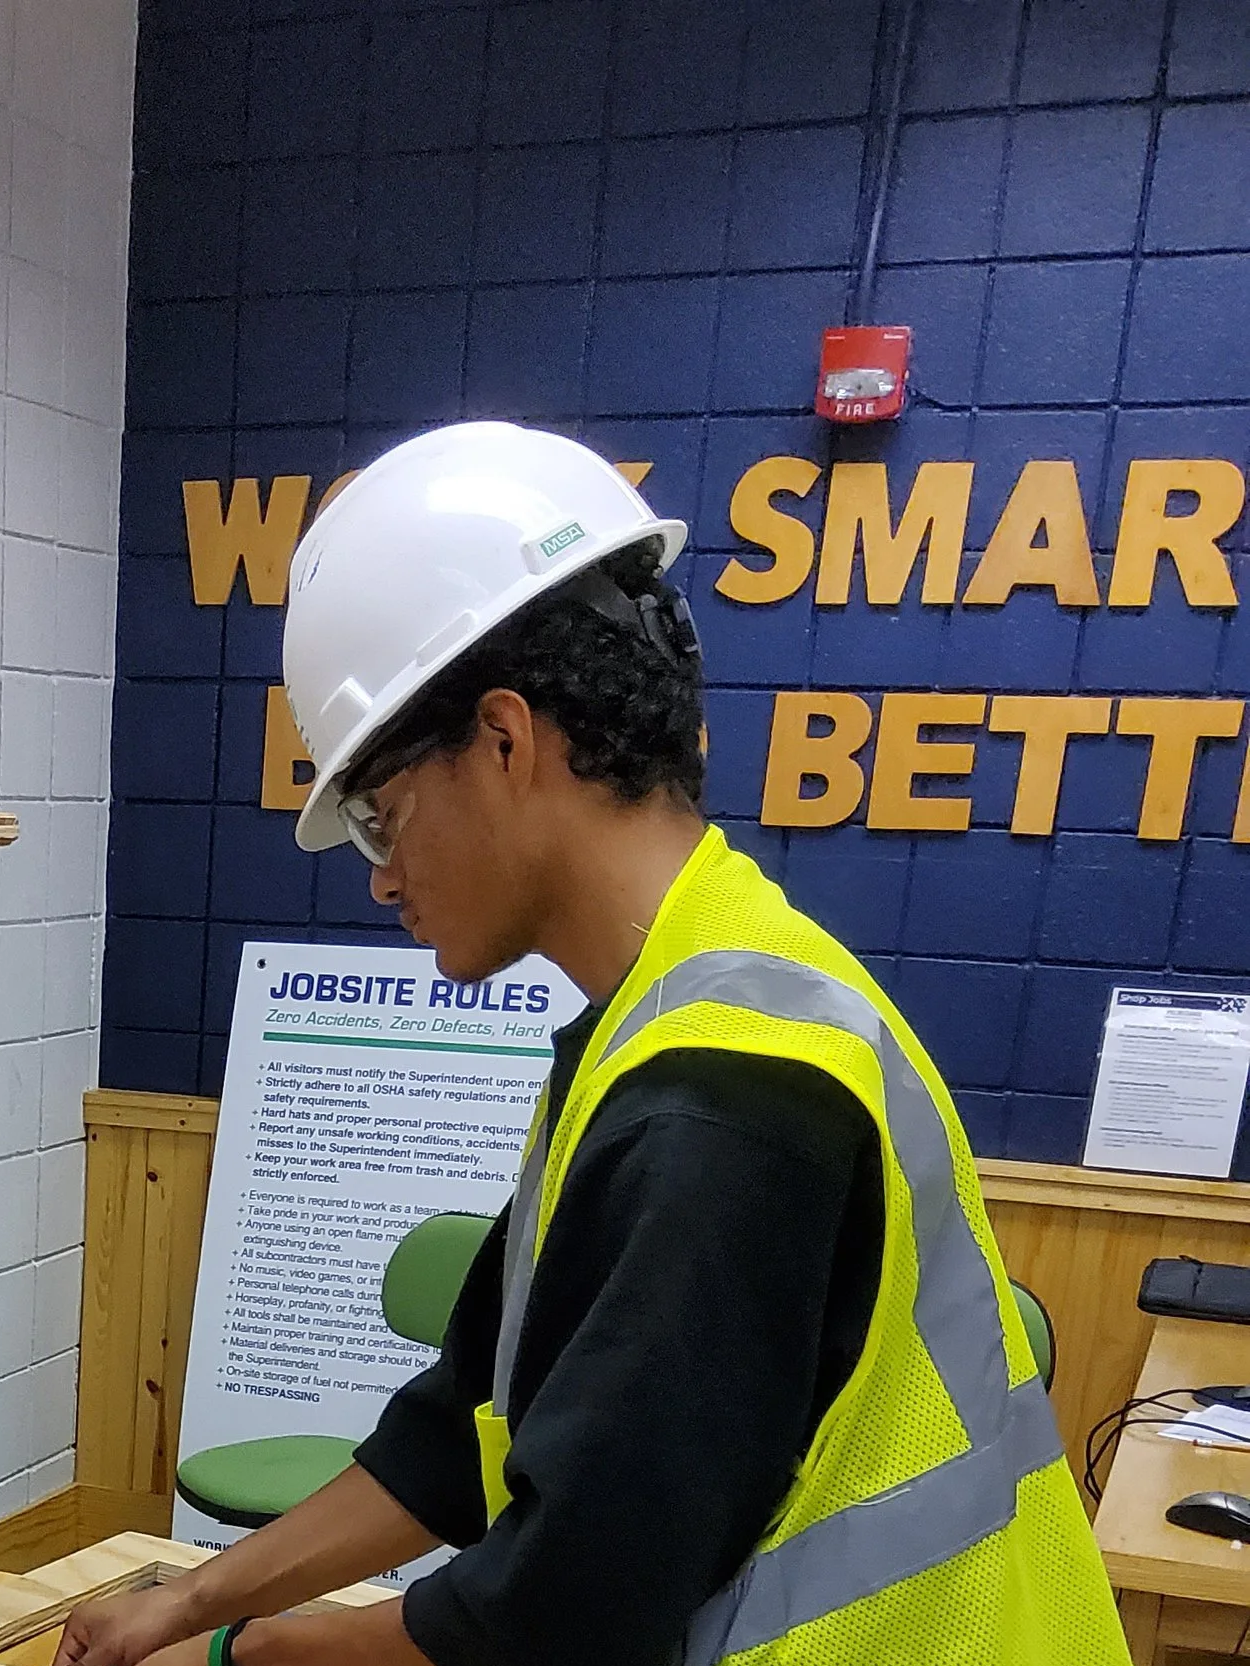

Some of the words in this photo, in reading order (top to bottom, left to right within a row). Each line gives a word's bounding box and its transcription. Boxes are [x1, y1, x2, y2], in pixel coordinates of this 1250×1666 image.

[835, 404, 876, 416] FIRE
[544, 525, 584, 555] MSA
[715, 456, 1239, 607] SMAR
[760, 690, 1250, 842] BETT
[270, 972, 416, 1007] JOBSITE
[428, 979, 551, 1014] RULES
[265, 1009, 300, 1024] Zero
[305, 1012, 383, 1030] Accidents,
[390, 1016, 427, 1031] Zero
[431, 1018, 495, 1036] Defects,
[503, 1022, 543, 1038] Hard
[266, 1061, 282, 1072] All
[283, 1062, 323, 1074] visitors
[325, 1066, 353, 1076] must
[354, 1067, 385, 1081] notify
[387, 1069, 406, 1080] the
[408, 1070, 494, 1085] Superintendent
[495, 1078, 525, 1089] upon
[263, 1092, 295, 1106] safety
[296, 1095, 370, 1108] requirements.
[264, 1076, 302, 1091] Strictly
[304, 1079, 341, 1091] adhere
[343, 1081, 354, 1092] to
[356, 1082, 370, 1093] all
[372, 1083, 405, 1095] OSHA
[407, 1087, 441, 1101] safety
[443, 1090, 506, 1102] regulations
[508, 1093, 531, 1104] and
[260, 1107, 286, 1118] Hard
[288, 1108, 311, 1120] hats
[313, 1111, 334, 1121] and
[335, 1114, 372, 1126] proper
[373, 1117, 422, 1128] personal
[423, 1120, 479, 1132] protective
[258, 1121, 294, 1135] Report
[295, 1126, 316, 1138] any
[317, 1127, 353, 1138] unsafe
[355, 1130, 399, 1144] working
[401, 1134, 463, 1148] conditions,
[256, 1137, 294, 1149] misses
[295, 1139, 307, 1150] to
[309, 1140, 326, 1151] the
[328, 1142, 411, 1158] Superintendent
[413, 1149, 483, 1166] immediately.
[251, 1167, 288, 1181] strictly
[289, 1170, 340, 1183] enforced.
[253, 1151, 281, 1165] Keep
[282, 1156, 308, 1166] your
[309, 1157, 336, 1167] work
[338, 1160, 362, 1169] area
[363, 1160, 385, 1171] free
[387, 1162, 412, 1173] from
[415, 1165, 444, 1176] trash
[446, 1168, 468, 1178] and
[469, 1169, 508, 1181] debris.
[248, 1189, 295, 1204] Everyone
[296, 1193, 306, 1204] is
[307, 1196, 349, 1208] required
[350, 1198, 361, 1208] to
[362, 1200, 387, 1210] work
[389, 1204, 402, 1213] as
[403, 1205, 411, 1213] a
[246, 1204, 271, 1216] Take
[272, 1208, 298, 1220] pride
[299, 1209, 309, 1220] in
[311, 1212, 334, 1223] your
[335, 1213, 360, 1224] work
[361, 1215, 381, 1226] and
[244, 1218, 282, 1232] Anyone
[283, 1223, 311, 1236] using
[312, 1226, 325, 1235] an
[327, 1228, 353, 1239] open
[354, 1228, 383, 1240] flame
[242, 1234, 306, 1251] extinguishing
[308, 1239, 343, 1252] device.
[240, 1247, 254, 1258] All
[255, 1250, 327, 1265] subcontractors
[328, 1257, 354, 1267] must
[355, 1258, 381, 1270] have
[238, 1262, 253, 1273] No
[255, 1265, 286, 1278] music,
[288, 1267, 316, 1279] video
[317, 1272, 354, 1284] games,
[356, 1275, 367, 1284] or
[236, 1277, 280, 1291] Personal
[281, 1281, 330, 1296] telephone
[331, 1287, 354, 1298] calls
[234, 1291, 285, 1308] Horseplay,
[287, 1298, 332, 1313] profanity,
[335, 1303, 347, 1312] or
[232, 1307, 246, 1318] All
[247, 1308, 271, 1320] tools
[272, 1312, 296, 1323] shall
[297, 1314, 310, 1324] be
[312, 1317, 367, 1330] maintained
[368, 1323, 388, 1333] and
[230, 1321, 272, 1335] Maintain
[273, 1328, 305, 1340] proper
[307, 1329, 344, 1346] training
[346, 1334, 366, 1345] and
[227, 1350, 243, 1362] the
[229, 1336, 268, 1350] Material
[269, 1340, 315, 1355] deliveries
[317, 1347, 337, 1357] and
[338, 1349, 376, 1364] storage
[378, 1354, 412, 1366] should
[414, 1357, 427, 1368] be
[225, 1365, 261, 1378] On-site
[262, 1370, 299, 1385] storage
[301, 1374, 311, 1384] of
[312, 1375, 331, 1386] fuel
[332, 1378, 349, 1388] not
[223, 1381, 241, 1393] NO
[243, 1384, 321, 1402] TRESPASSING
